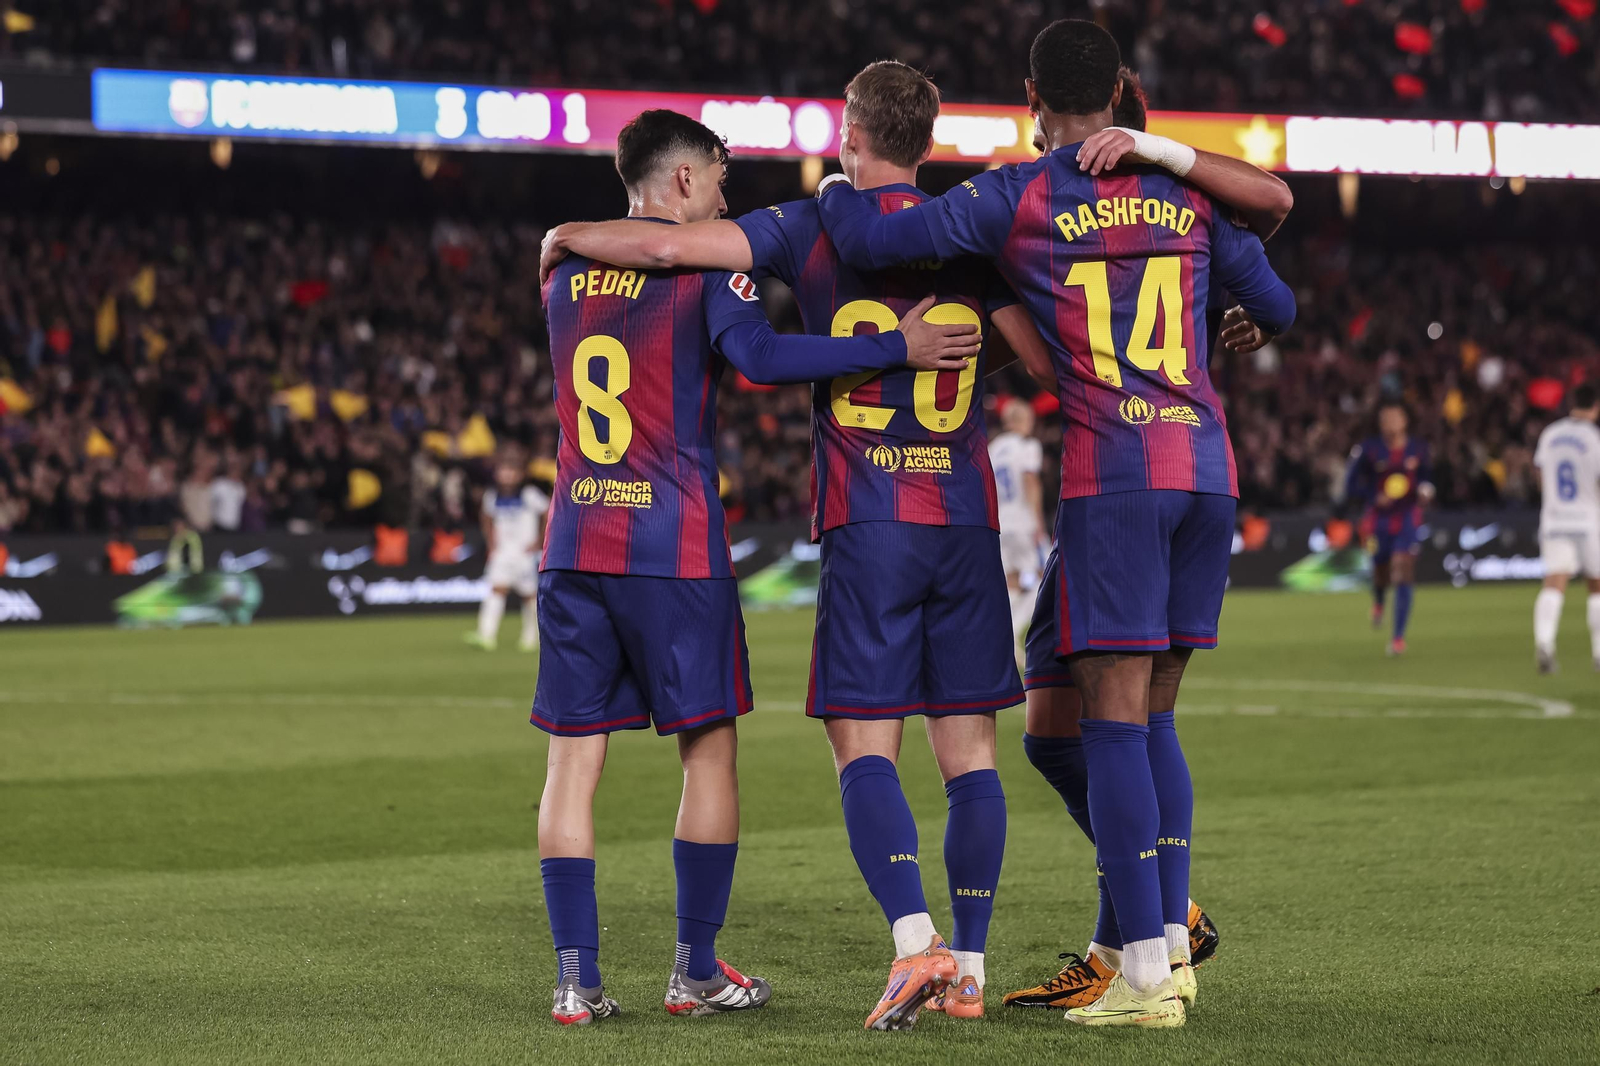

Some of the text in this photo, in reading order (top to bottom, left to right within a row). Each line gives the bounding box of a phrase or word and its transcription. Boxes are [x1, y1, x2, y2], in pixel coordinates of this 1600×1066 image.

[1054, 197, 1196, 242] RASHFORD
[570, 269, 647, 302] PEDRI
[1063, 256, 1193, 388] 14
[830, 299, 983, 433] 20
[573, 334, 633, 464] 8
[902, 446, 950, 458] UNHCR
[904, 457, 952, 469] ACNUR
[603, 479, 652, 493] UNHCR
[1556, 460, 1578, 502] 6
[603, 490, 652, 504] ACNUR
[1156, 837, 1188, 848] ARÇA
[956, 888, 991, 898] BARÇA
